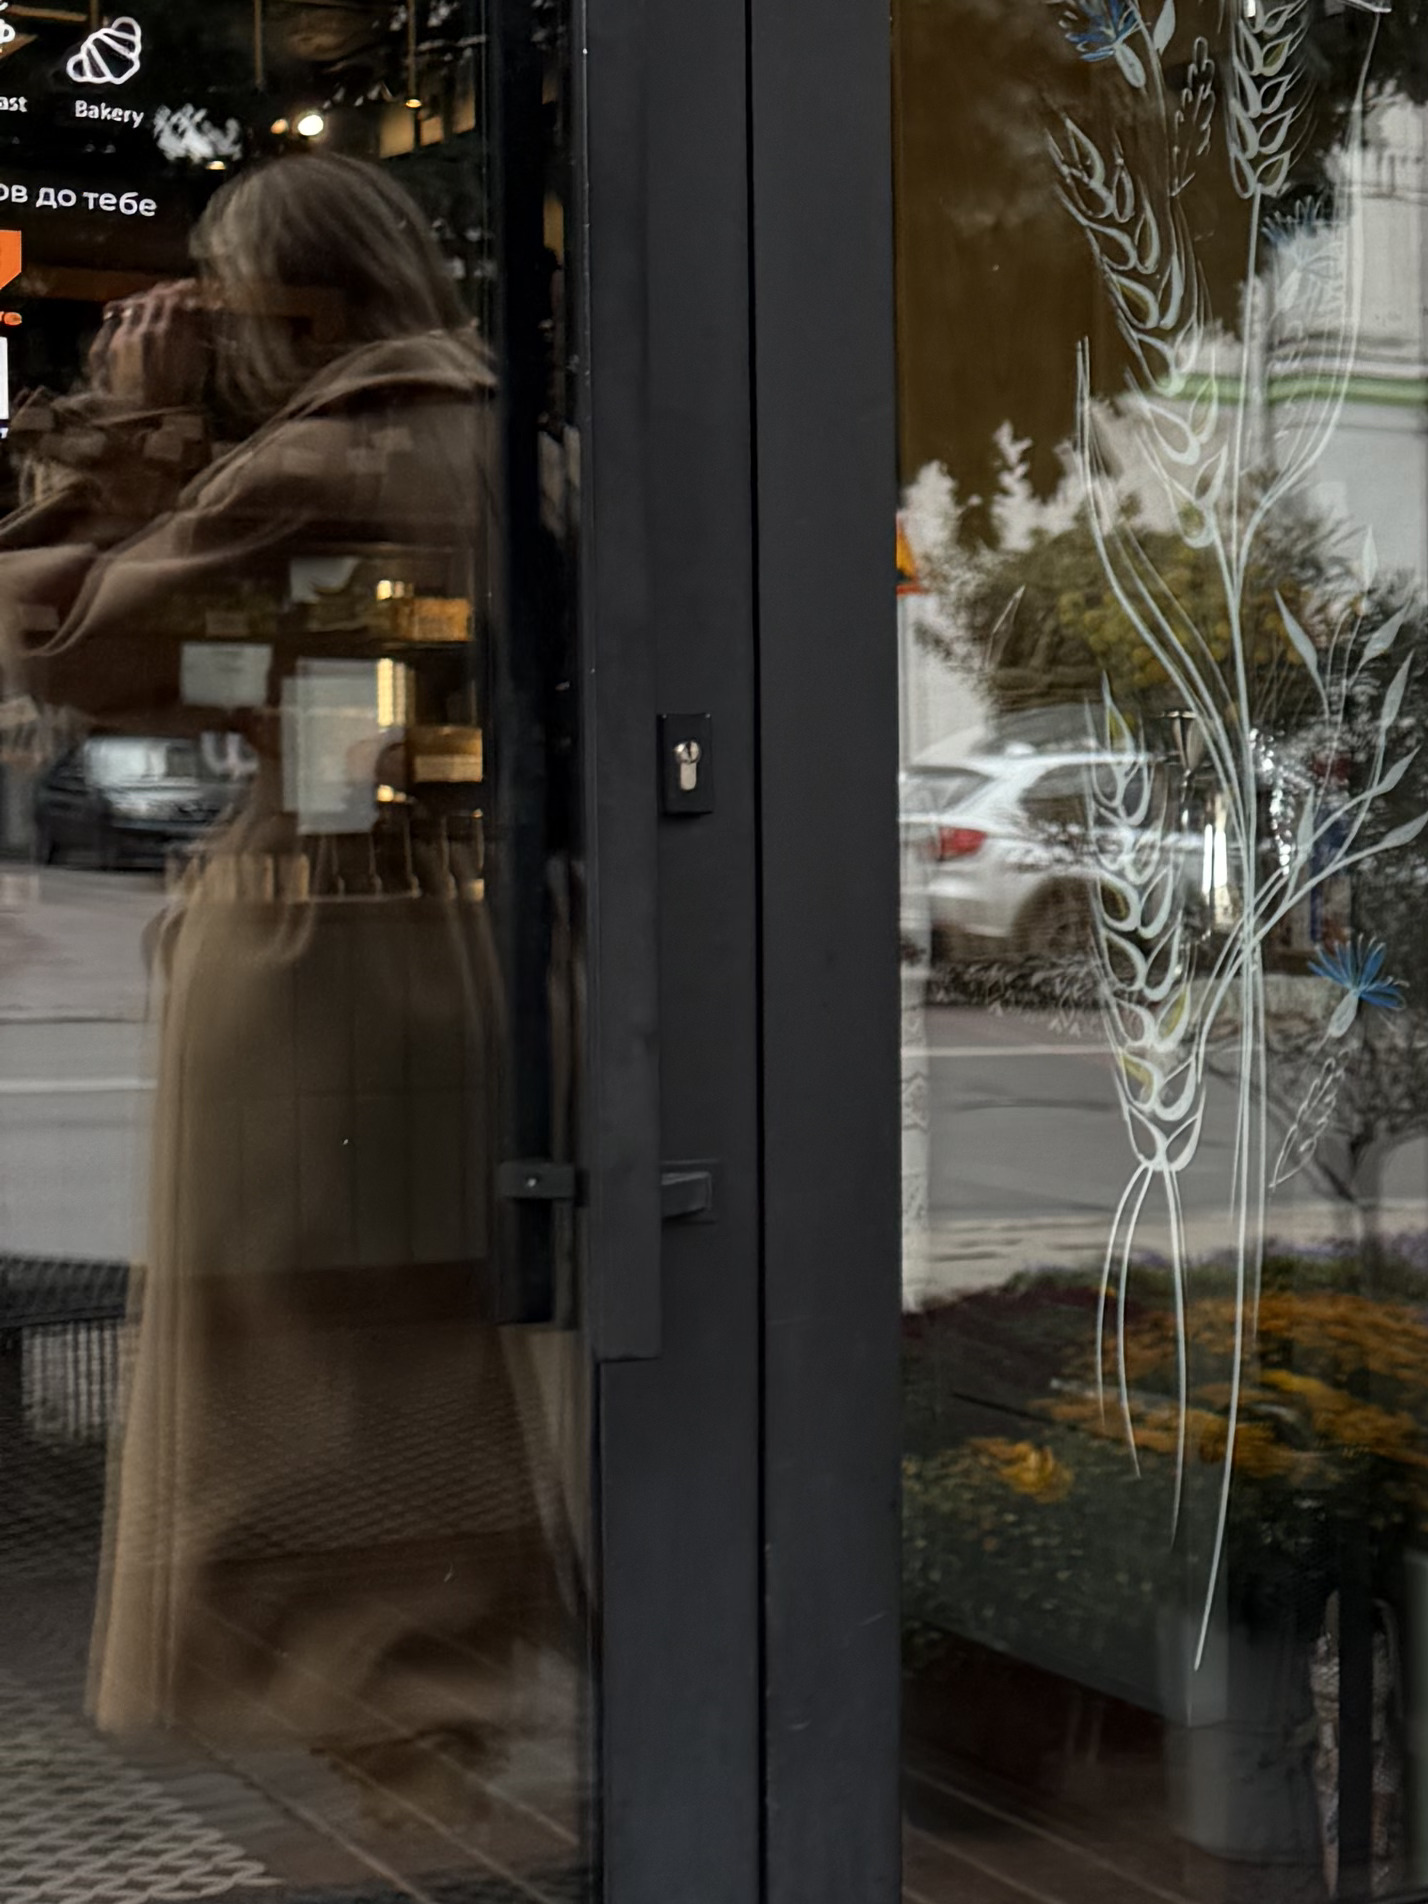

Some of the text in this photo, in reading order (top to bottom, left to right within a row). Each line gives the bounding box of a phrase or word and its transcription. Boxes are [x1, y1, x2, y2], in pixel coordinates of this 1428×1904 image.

[74, 99, 145, 129] Bakery
[36, 186, 78, 209] до
[82, 191, 157, 218] тебе
